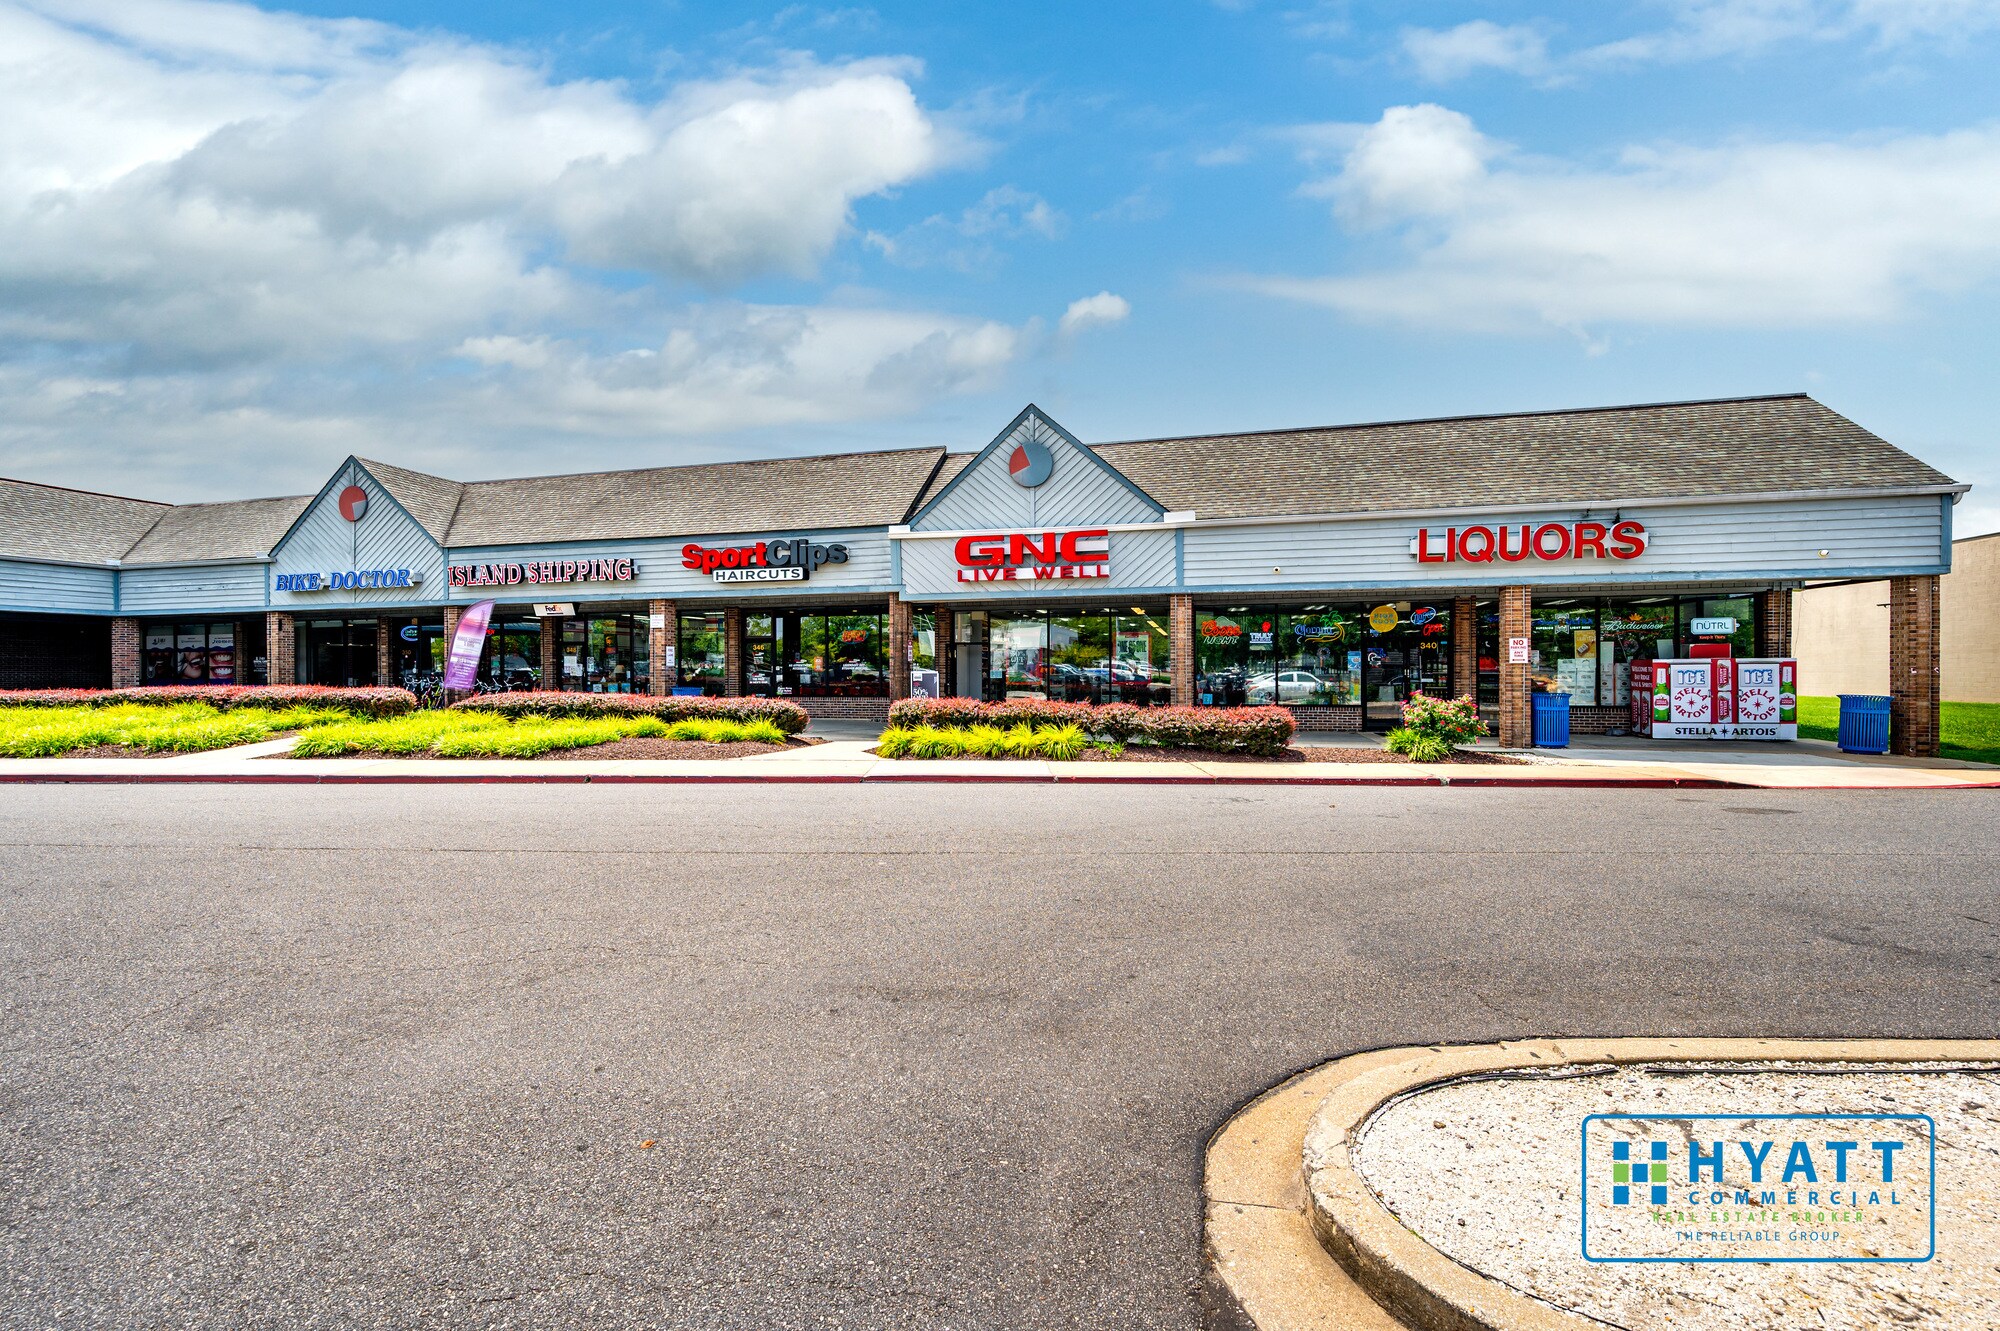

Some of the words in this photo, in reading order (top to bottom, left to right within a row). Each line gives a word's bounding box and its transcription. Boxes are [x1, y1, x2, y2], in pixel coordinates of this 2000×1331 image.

[955, 529, 1109, 566] GNC
[1417, 521, 1646, 563] LIQUORS
[275, 572, 322, 592] BIKE
[329, 568, 413, 590] DOCTOR
[447, 563, 523, 587] ISLAND
[528, 558, 632, 583] SHIPPING
[715, 568, 801, 581] HAIRCUTS
[957, 568, 1017, 582] LIVE
[1033, 564, 1109, 580] WELL
[1201, 620, 1243, 636] Coors
[1294, 624, 1333, 636] Corona
[1603, 620, 1664, 631] Budweiser
[1203, 635, 1240, 644] LIGHT
[1250, 632, 1274, 640] TRULY
[1677, 669, 1706, 685] ICE
[1744, 669, 1773, 685] ICE
[1674, 687, 1708, 702] STELLA
[1740, 688, 1775, 703] STELLA
[1674, 704, 1709, 718] ARTOIS
[1740, 706, 1776, 721] ARTOIS
[1675, 727, 1717, 735] STELLA
